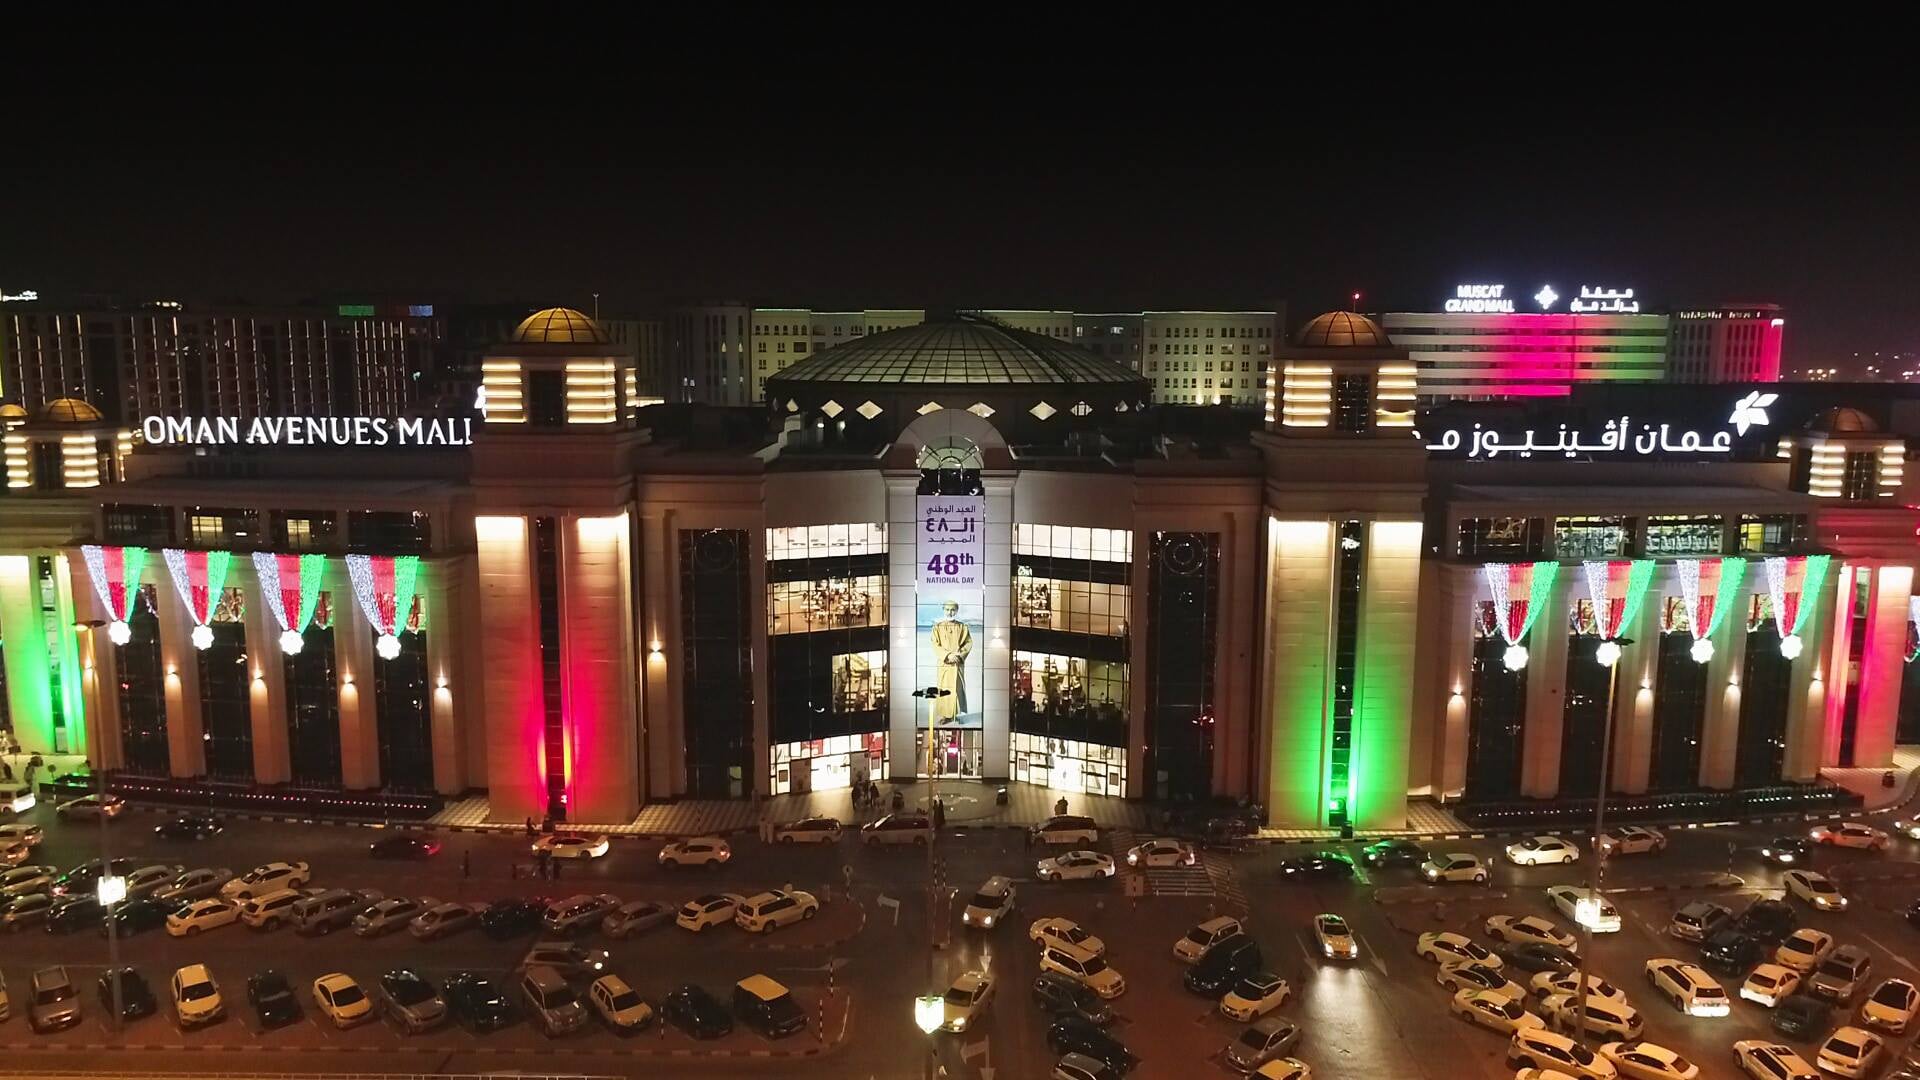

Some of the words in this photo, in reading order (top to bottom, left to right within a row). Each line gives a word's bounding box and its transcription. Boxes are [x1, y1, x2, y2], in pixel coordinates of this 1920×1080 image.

[1457, 284, 1504, 298] MUSCAT
[143, 416, 238, 445] OMAN
[246, 416, 389, 445] AVENUES
[1635, 424, 1731, 455] عمان
[926, 505, 954, 517] الوطني
[956, 505, 976, 515] العيد
[927, 552, 974, 575] 48th
